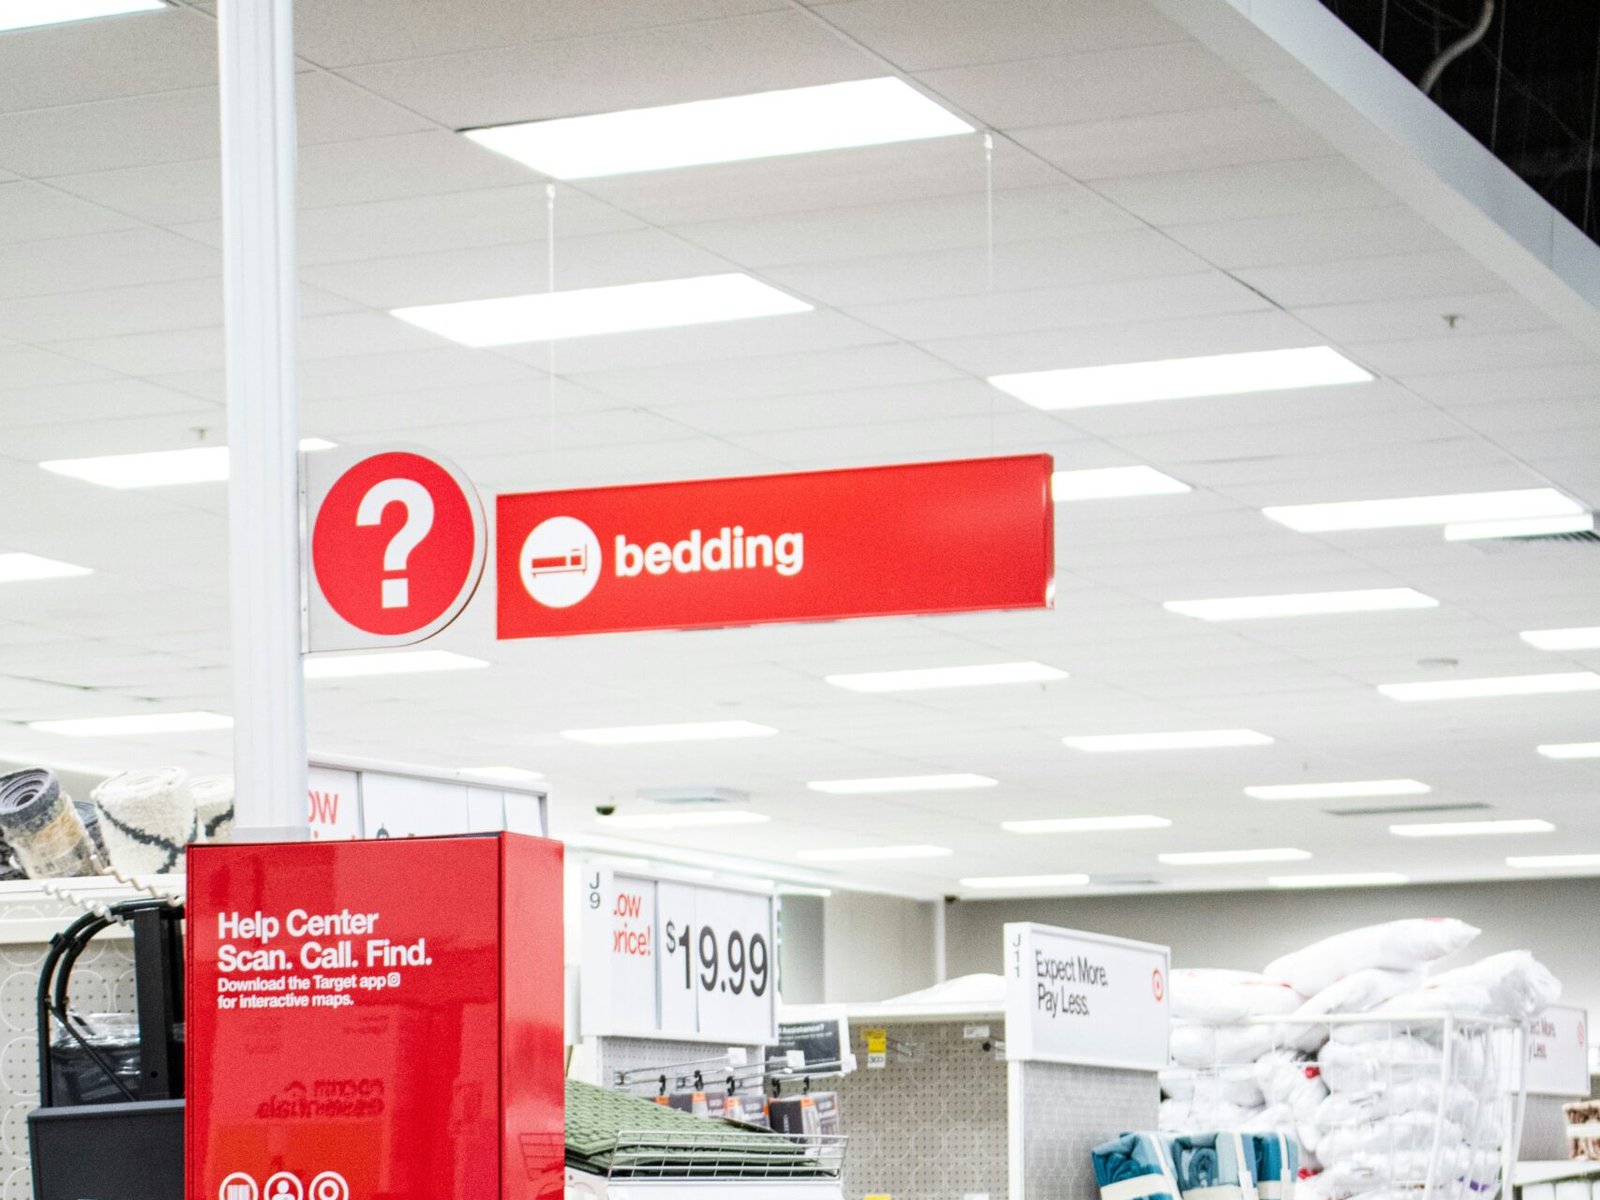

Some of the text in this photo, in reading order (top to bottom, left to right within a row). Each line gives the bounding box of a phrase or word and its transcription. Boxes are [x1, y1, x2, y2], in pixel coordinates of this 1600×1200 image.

[613, 526, 805, 577] bedding
[613, 893, 642, 918] ow
[217, 908, 379, 944] Help Center
[217, 938, 433, 973] Scan. Call. Find.
[665, 919, 769, 998] $19.99
[1034, 949, 1109, 987] Expect More.
[217, 973, 386, 993] Download the Target app
[217, 993, 354, 1009] for interactive maps.
[1037, 982, 1090, 1019] Pay Less.
